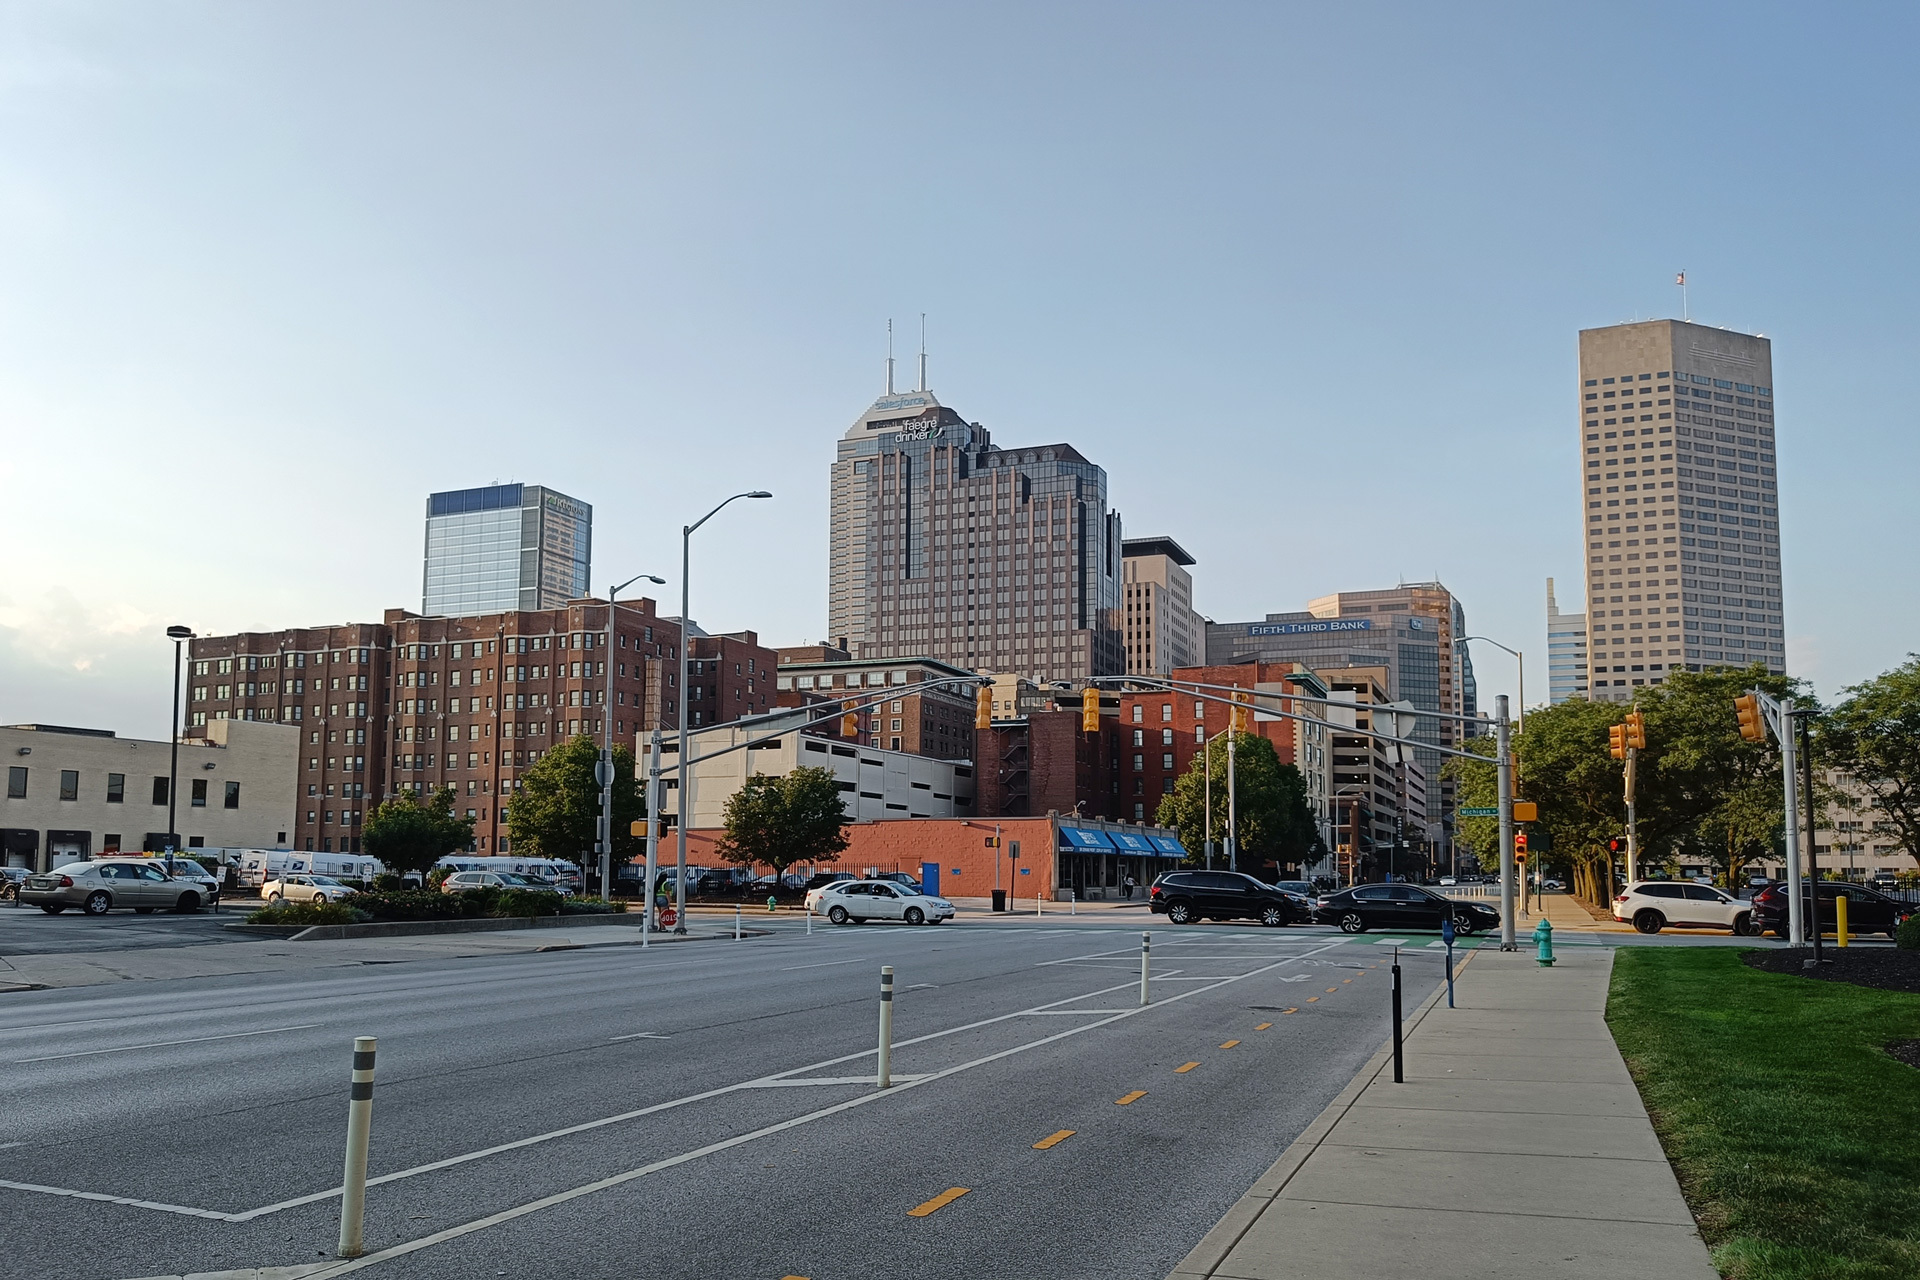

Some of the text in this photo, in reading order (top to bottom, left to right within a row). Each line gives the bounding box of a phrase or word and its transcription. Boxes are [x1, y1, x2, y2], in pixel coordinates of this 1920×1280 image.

[875, 397, 925, 410] salesforce
[904, 419, 937, 431] faegre
[895, 430, 929, 442] drinker
[1252, 621, 1365, 635] FIFTH THIRD BANK
[661, 913, 677, 922] STOP
